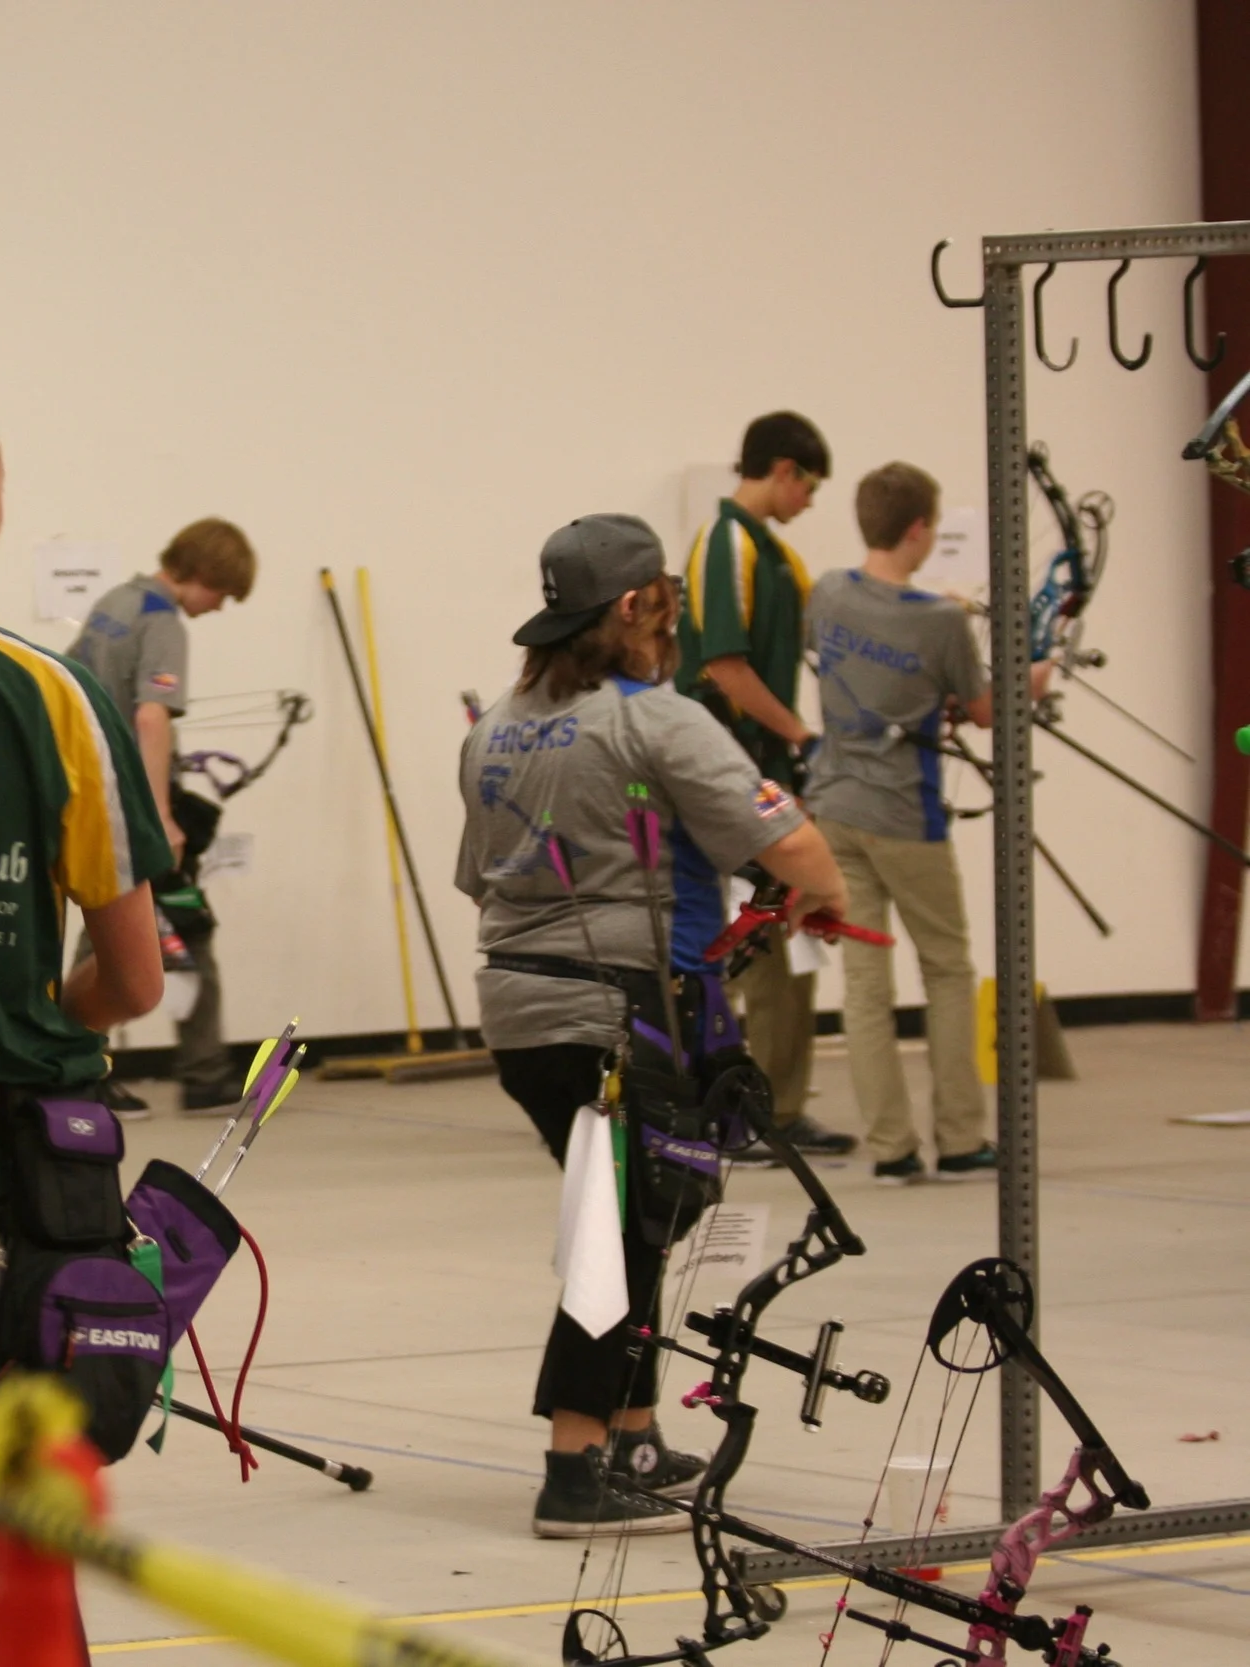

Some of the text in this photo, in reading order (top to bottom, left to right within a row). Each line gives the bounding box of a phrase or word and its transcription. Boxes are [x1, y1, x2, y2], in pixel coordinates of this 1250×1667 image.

[487, 715, 580, 755] HICKS
[665, 1142, 717, 1161] EASTON
[88, 1327, 161, 1351] EASTON
